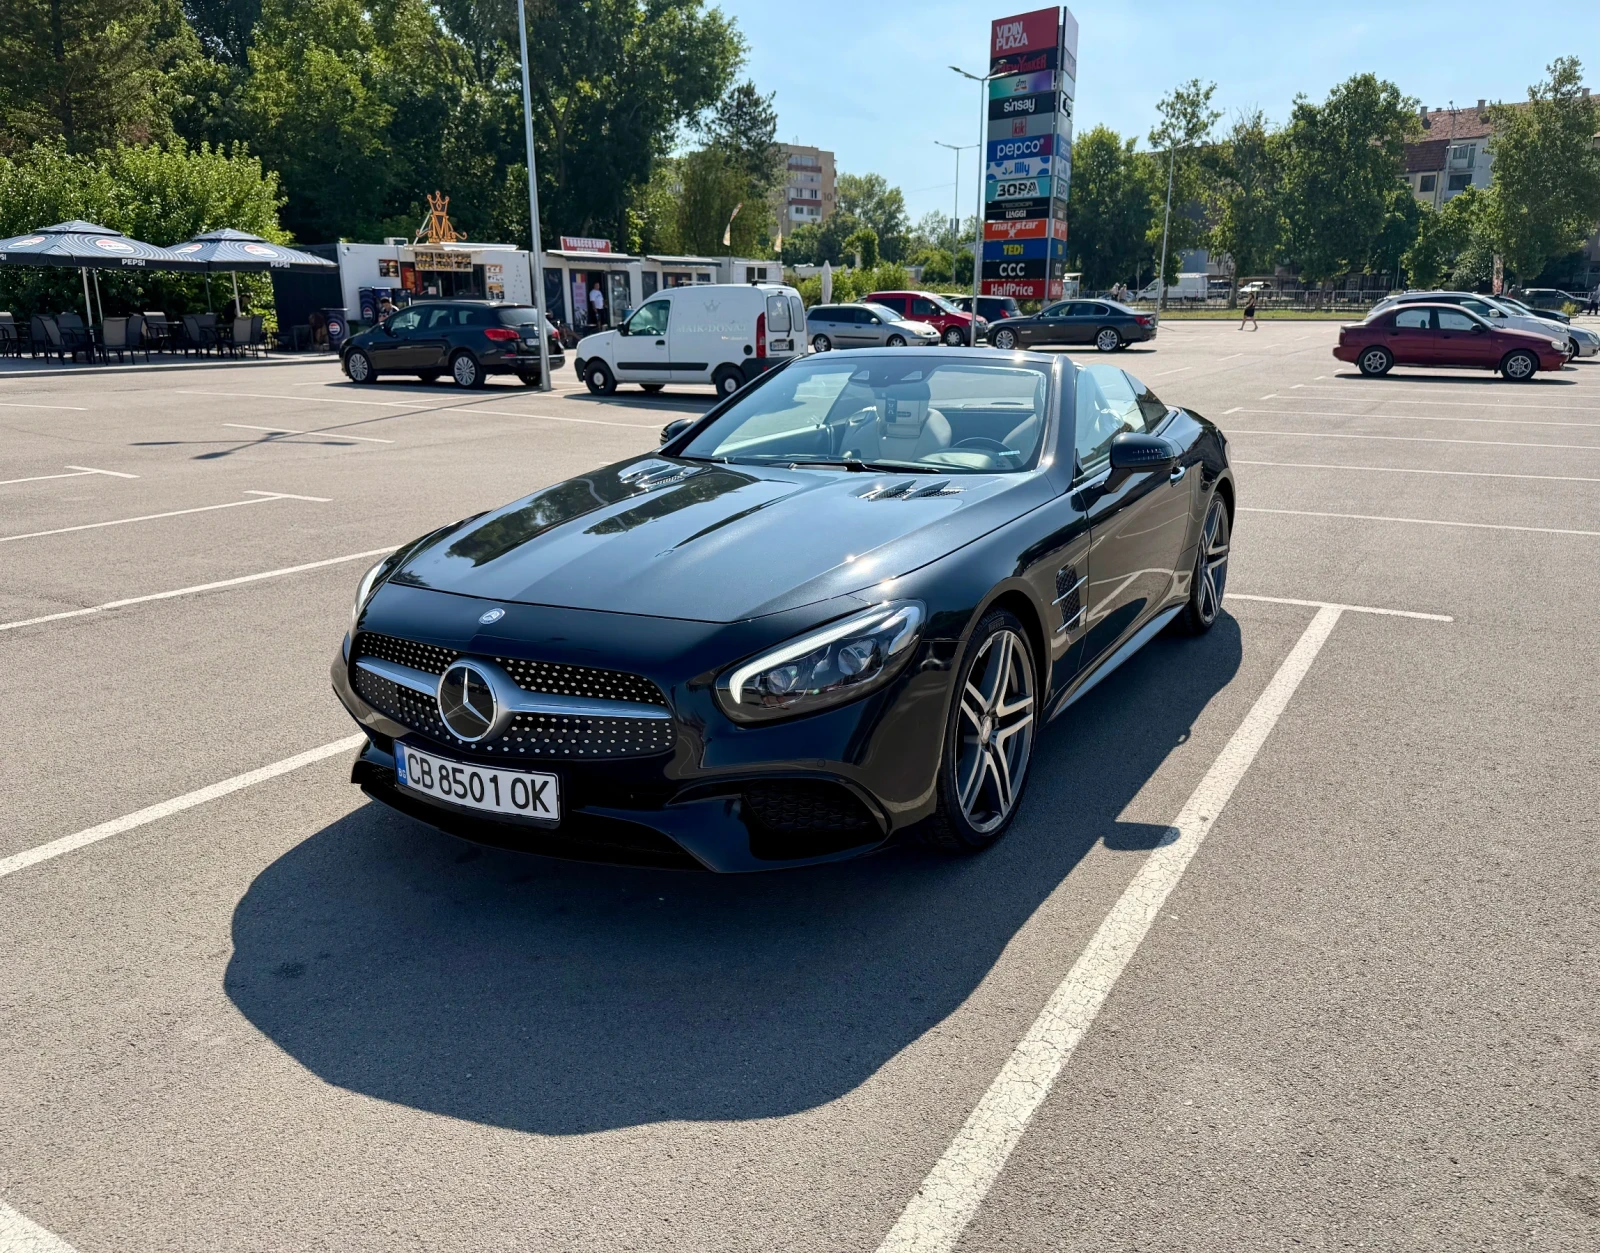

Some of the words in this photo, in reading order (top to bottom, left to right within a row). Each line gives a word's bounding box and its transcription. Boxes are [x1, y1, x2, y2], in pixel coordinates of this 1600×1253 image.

[997, 21, 1024, 38] VIDIN
[995, 33, 1028, 51] PLAZA
[1003, 98, 1036, 112] sinsay
[997, 140, 1040, 159] pepco
[1014, 162, 1030, 175] lilly
[1015, 221, 1039, 230] star
[1003, 244, 1024, 255] TEDi
[121, 258, 146, 267] PEPSI
[270, 260, 291, 269] PEPSI
[999, 263, 1026, 277] CCC
[990, 283, 1033, 296] HalfPrice
[397, 767, 407, 779] BG
[408, 753, 434, 789] CB
[438, 764, 501, 807] 8501
[510, 777, 550, 813] OK
